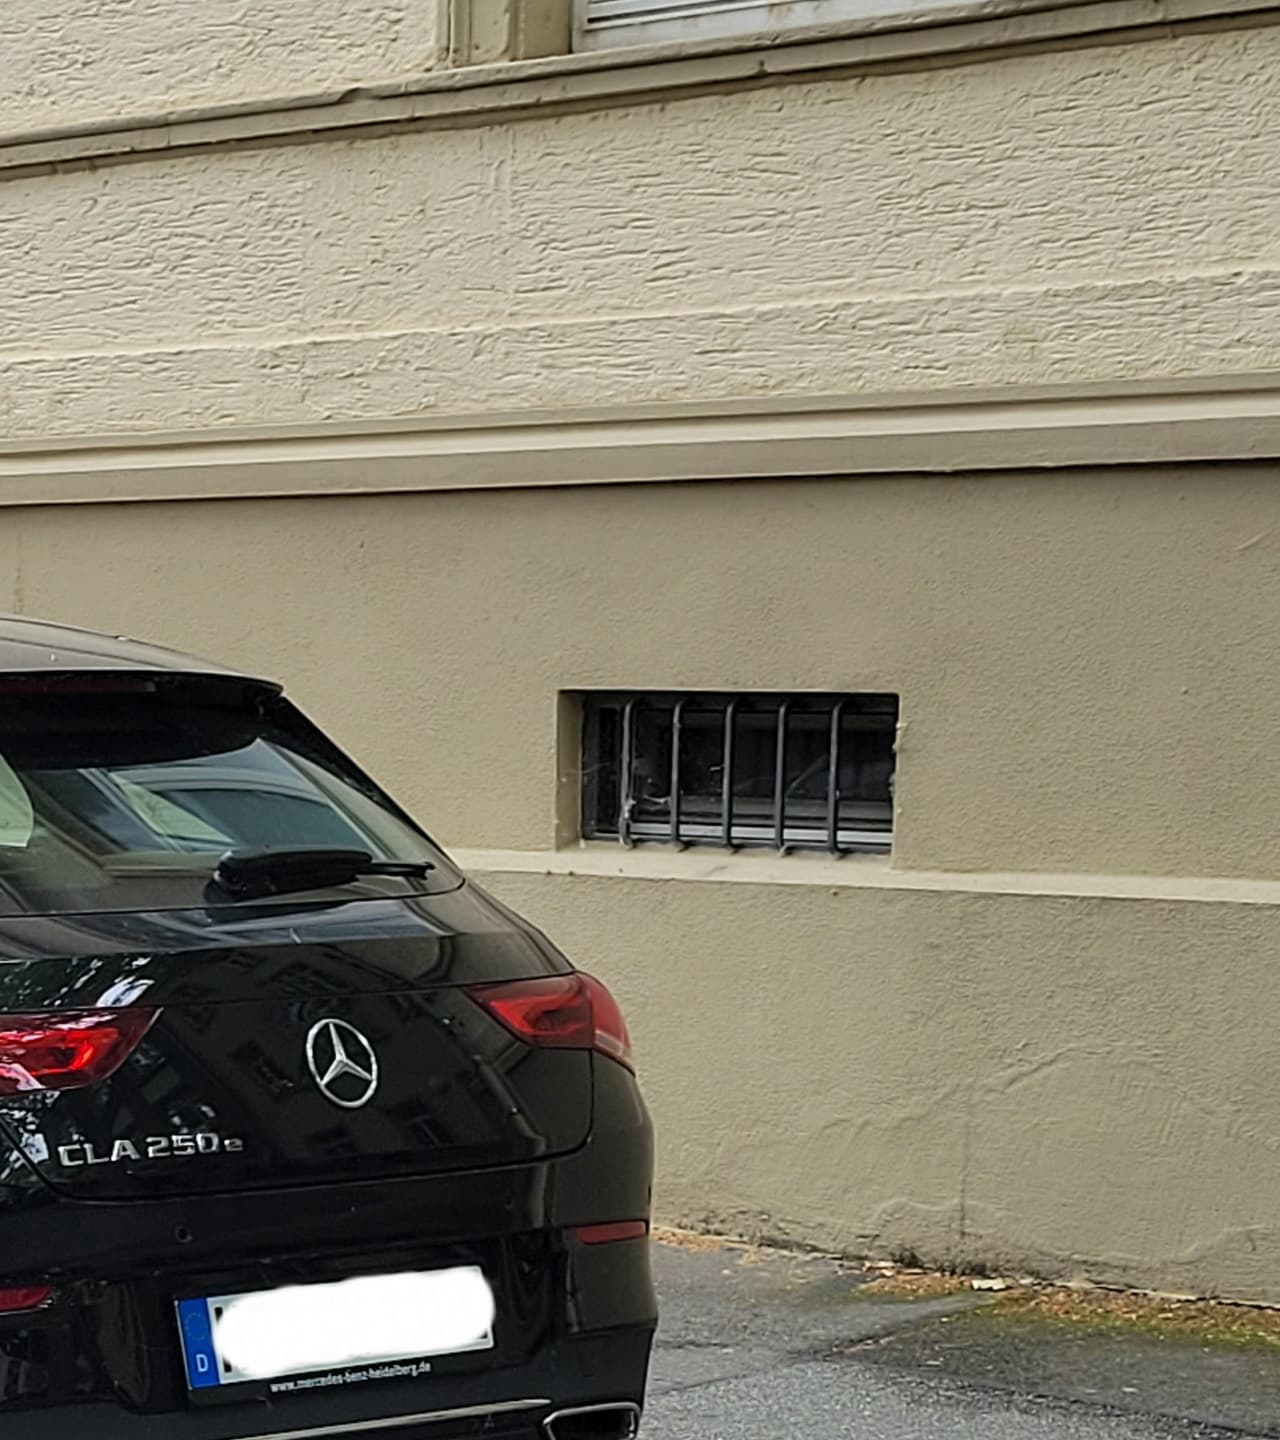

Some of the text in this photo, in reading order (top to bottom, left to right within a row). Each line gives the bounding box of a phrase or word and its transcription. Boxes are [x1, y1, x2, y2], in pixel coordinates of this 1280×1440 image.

[57, 1139, 141, 1167] CLA
[196, 1353, 209, 1373] D
[269, 1361, 432, 1393] www.mercedes-benz-heidelberg.de
